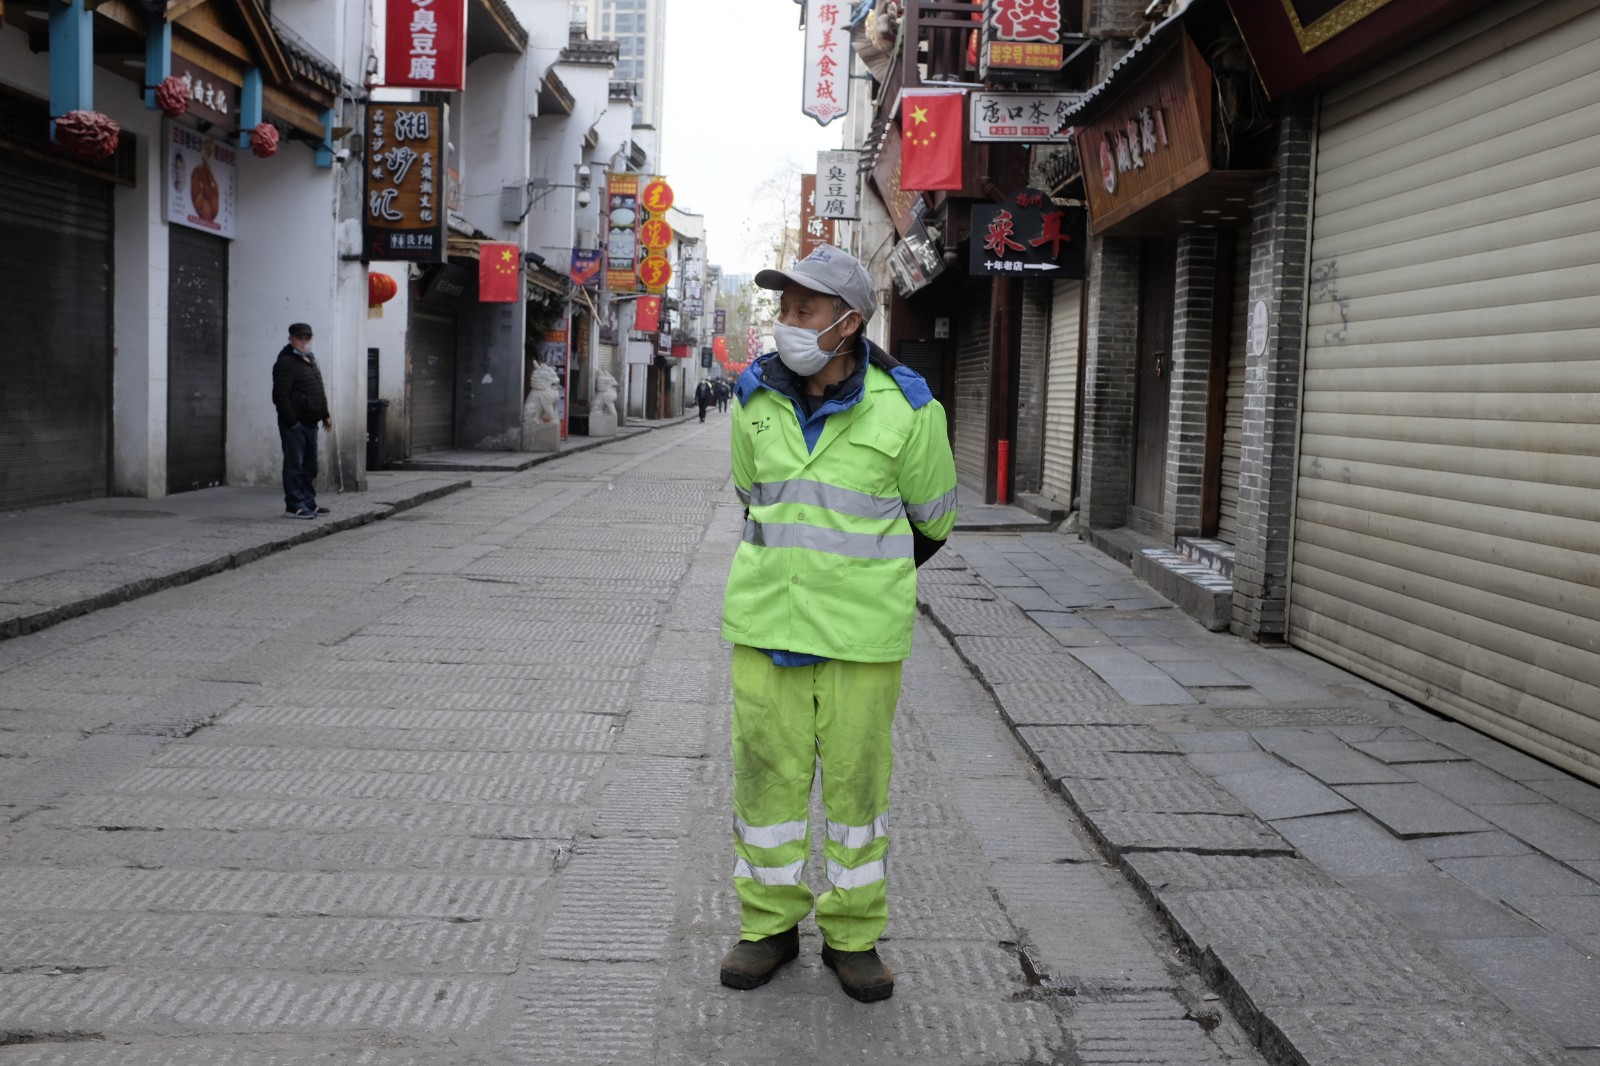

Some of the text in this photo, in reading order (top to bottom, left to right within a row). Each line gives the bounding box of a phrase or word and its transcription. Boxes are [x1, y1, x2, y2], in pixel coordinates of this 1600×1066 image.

[816, 3, 839, 103] 街美食城
[991, 44, 1023, 64] 老字号
[824, 165, 848, 216] 臭豆腐
[983, 208, 1073, 261] 采耳
[983, 260, 1024, 271] 十年老店
